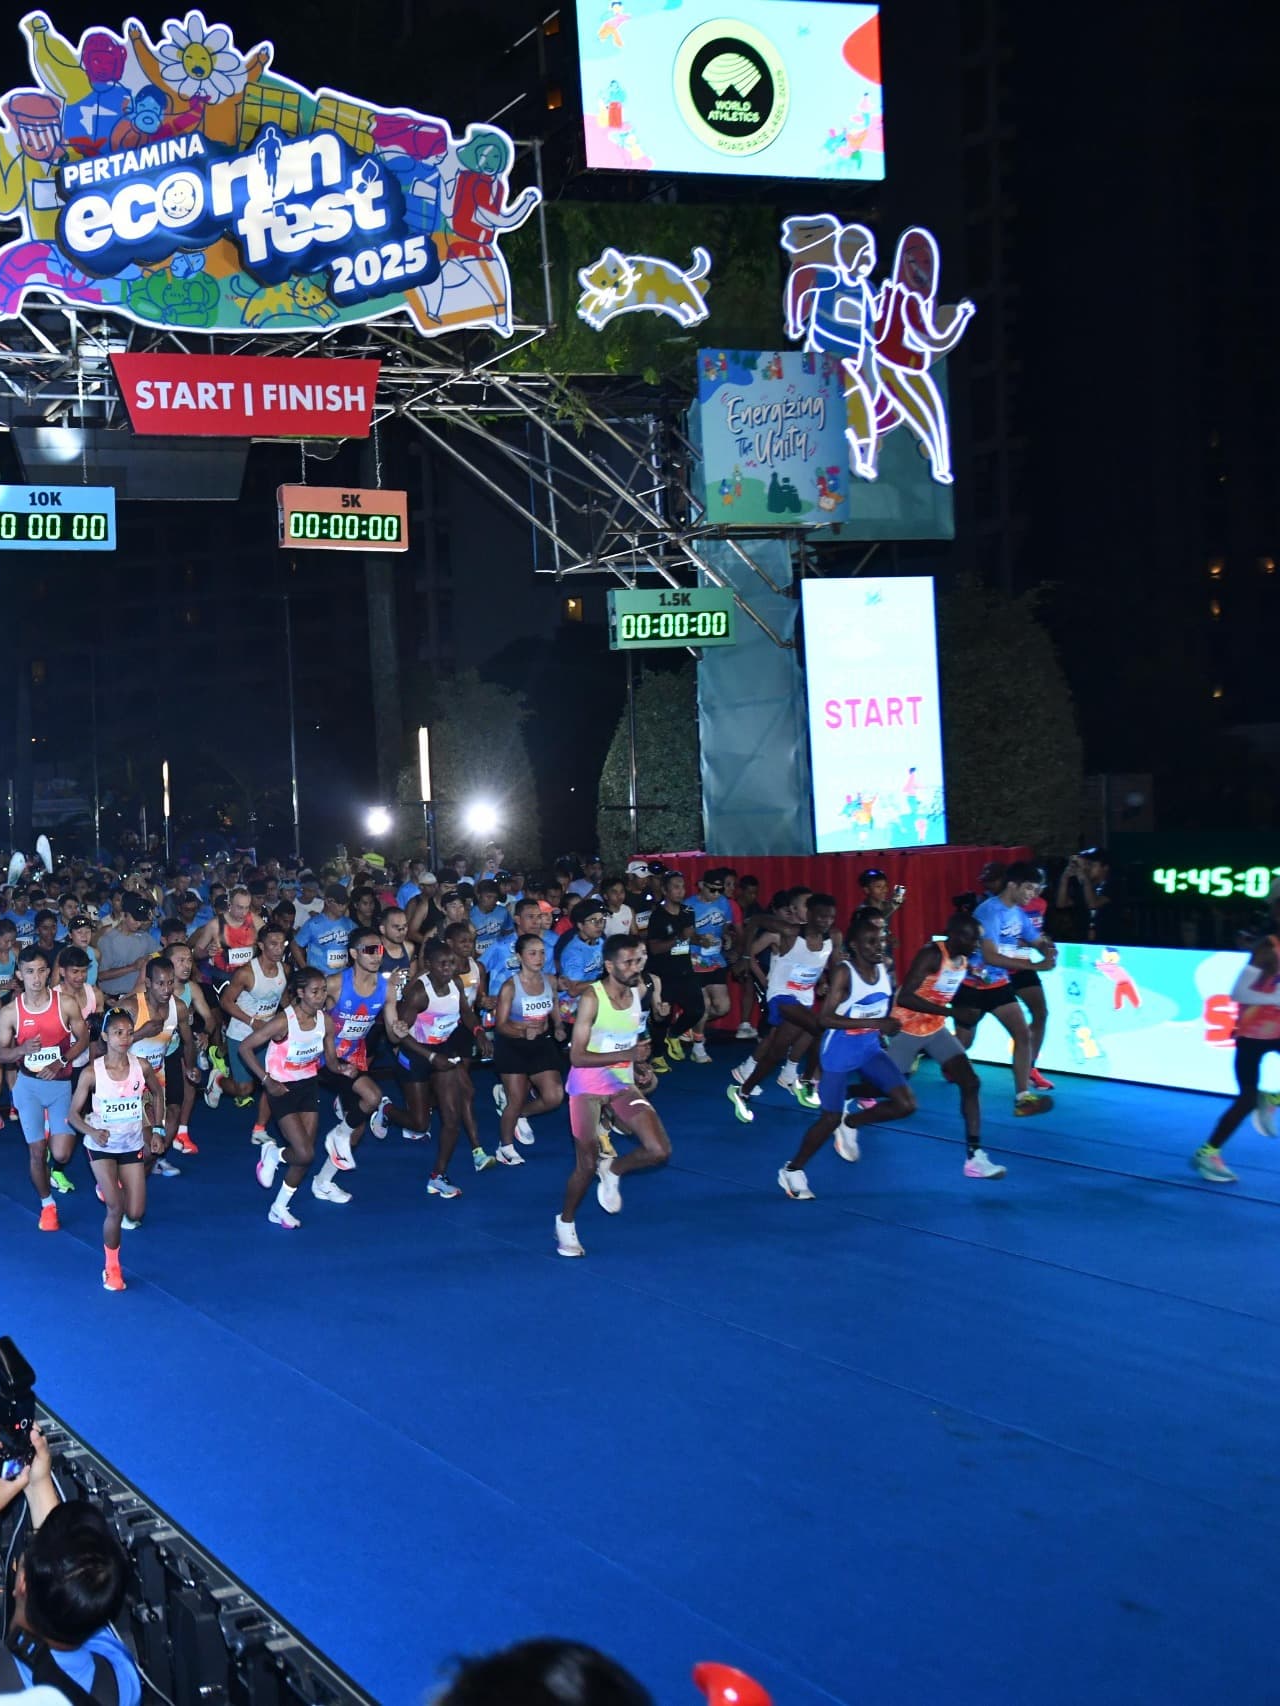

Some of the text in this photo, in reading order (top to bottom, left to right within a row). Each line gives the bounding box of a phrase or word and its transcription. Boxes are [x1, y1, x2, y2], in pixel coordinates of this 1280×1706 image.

[707, 110, 761, 122] ATHLETICS
[715, 100, 752, 112] WORLD
[64, 133, 205, 189] PERTAMINA
[64, 132, 342, 252] eco run
[237, 163, 387, 264] fest
[331, 235, 428, 294] 2025
[135, 380, 235, 410] START
[263, 384, 366, 412] FINISH
[726, 394, 825, 435] Energizing
[736, 426, 809, 467] The Unity
[28, 491, 62, 506] 10K
[341, 494, 362, 508] 5K
[289, 513, 398, 541] 00:00:00
[658, 592, 691, 607] 1.5K
[622, 612, 727, 639] 00:00:00
[825, 697, 922, 728] START
[525, 1001, 552, 1011] 20005
[27, 1053, 57, 1062] 23008
[105, 1103, 138, 1113] 25016
